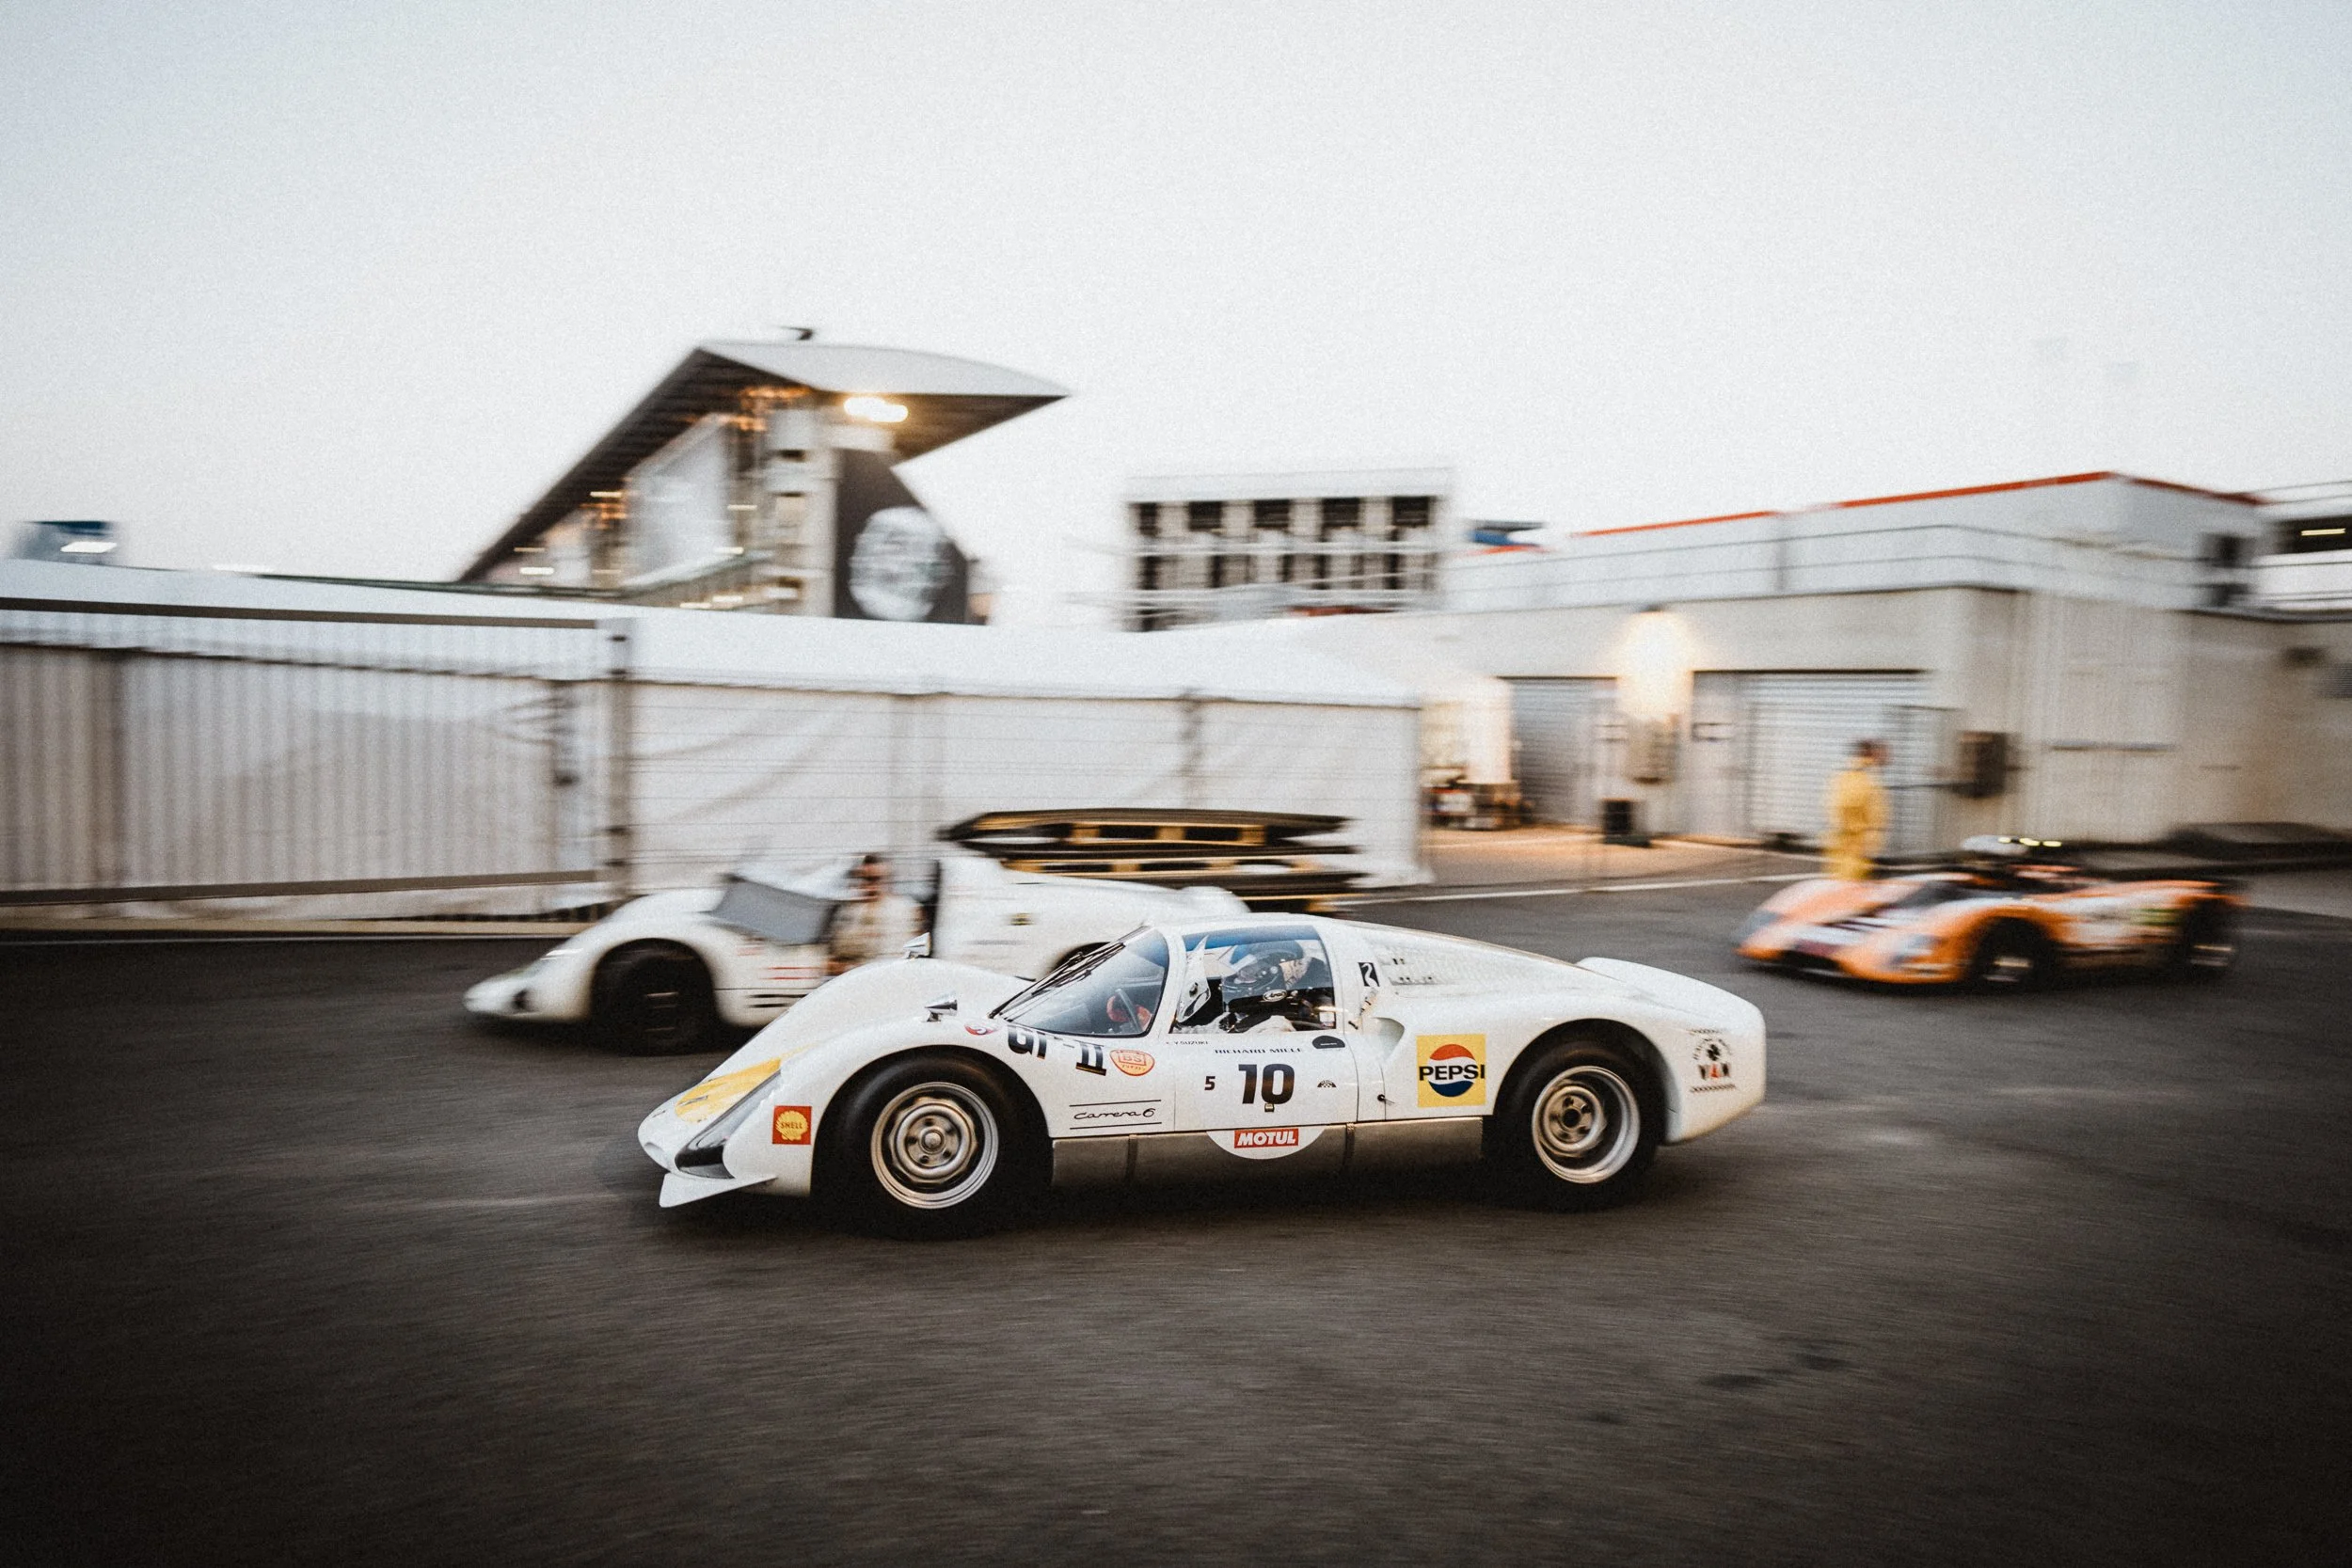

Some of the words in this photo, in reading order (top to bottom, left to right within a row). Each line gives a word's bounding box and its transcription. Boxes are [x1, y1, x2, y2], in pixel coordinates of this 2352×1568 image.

[1419, 1064, 1486, 1081] PEPSI
[1204, 1076, 1216, 1091] 5
[1238, 1063, 1295, 1104] 10
[1074, 1111, 1141, 1120] Carrera
[1142, 1108, 1156, 1117] 6
[1237, 1131, 1296, 1146] MOTUL
